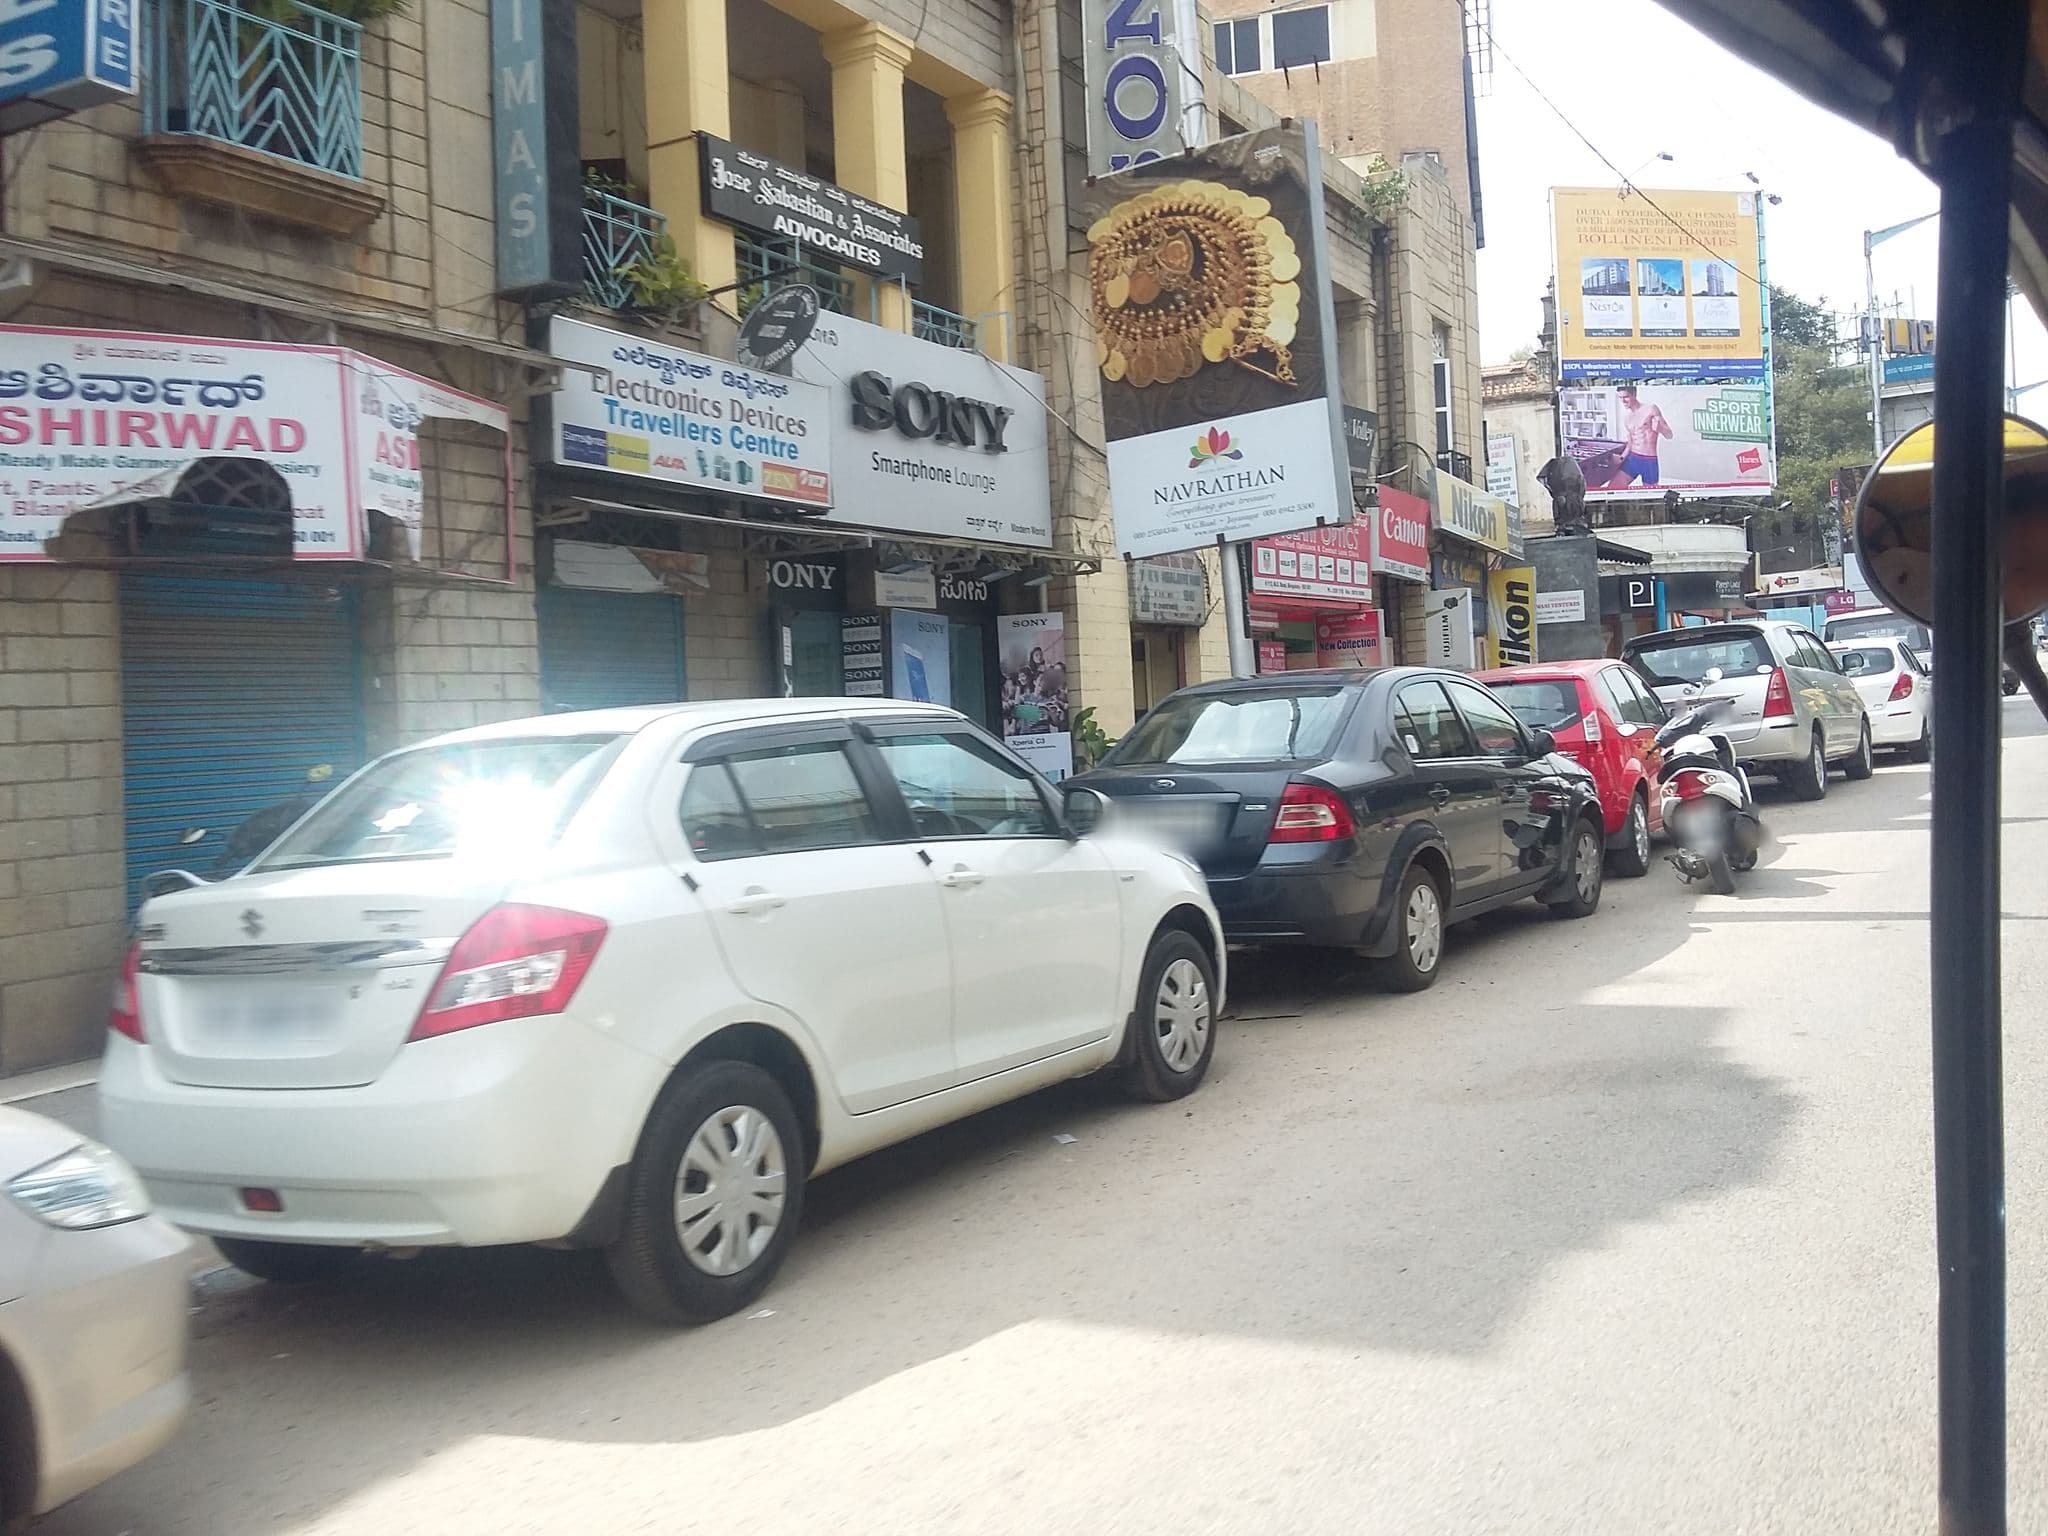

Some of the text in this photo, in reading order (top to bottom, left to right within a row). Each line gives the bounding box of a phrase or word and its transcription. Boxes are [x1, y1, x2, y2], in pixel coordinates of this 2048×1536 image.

[711, 157, 753, 193] Jose
[834, 214, 850, 230] &
[851, 213, 925, 260] Associates
[773, 214, 882, 267] ADVOCATES
[1679, 236, 1738, 247] HOMES
[591, 373, 807, 437] Electronics Devices
[851, 370, 1015, 454] SONY
[1694, 412, 1762, 433] INNERWEAR
[1708, 400, 1761, 414] SPORT
[603, 398, 799, 460] Travellers Centre
[871, 451, 996, 494] Smartphone Lounge
[1153, 465, 1284, 504] NAVRATHAN
[1383, 508, 1426, 548] Canon
[1451, 484, 1497, 542] Nikon
[842, 616, 879, 626] SONY
[918, 621, 945, 634] SONY
[1012, 619, 1048, 628] SONY
[1441, 614, 1450, 658] FUJIFILM
[1498, 580, 1531, 668] ikon
[843, 643, 881, 653] SONY
[1337, 638, 1377, 650] Collection
[845, 670, 881, 680] SONY
